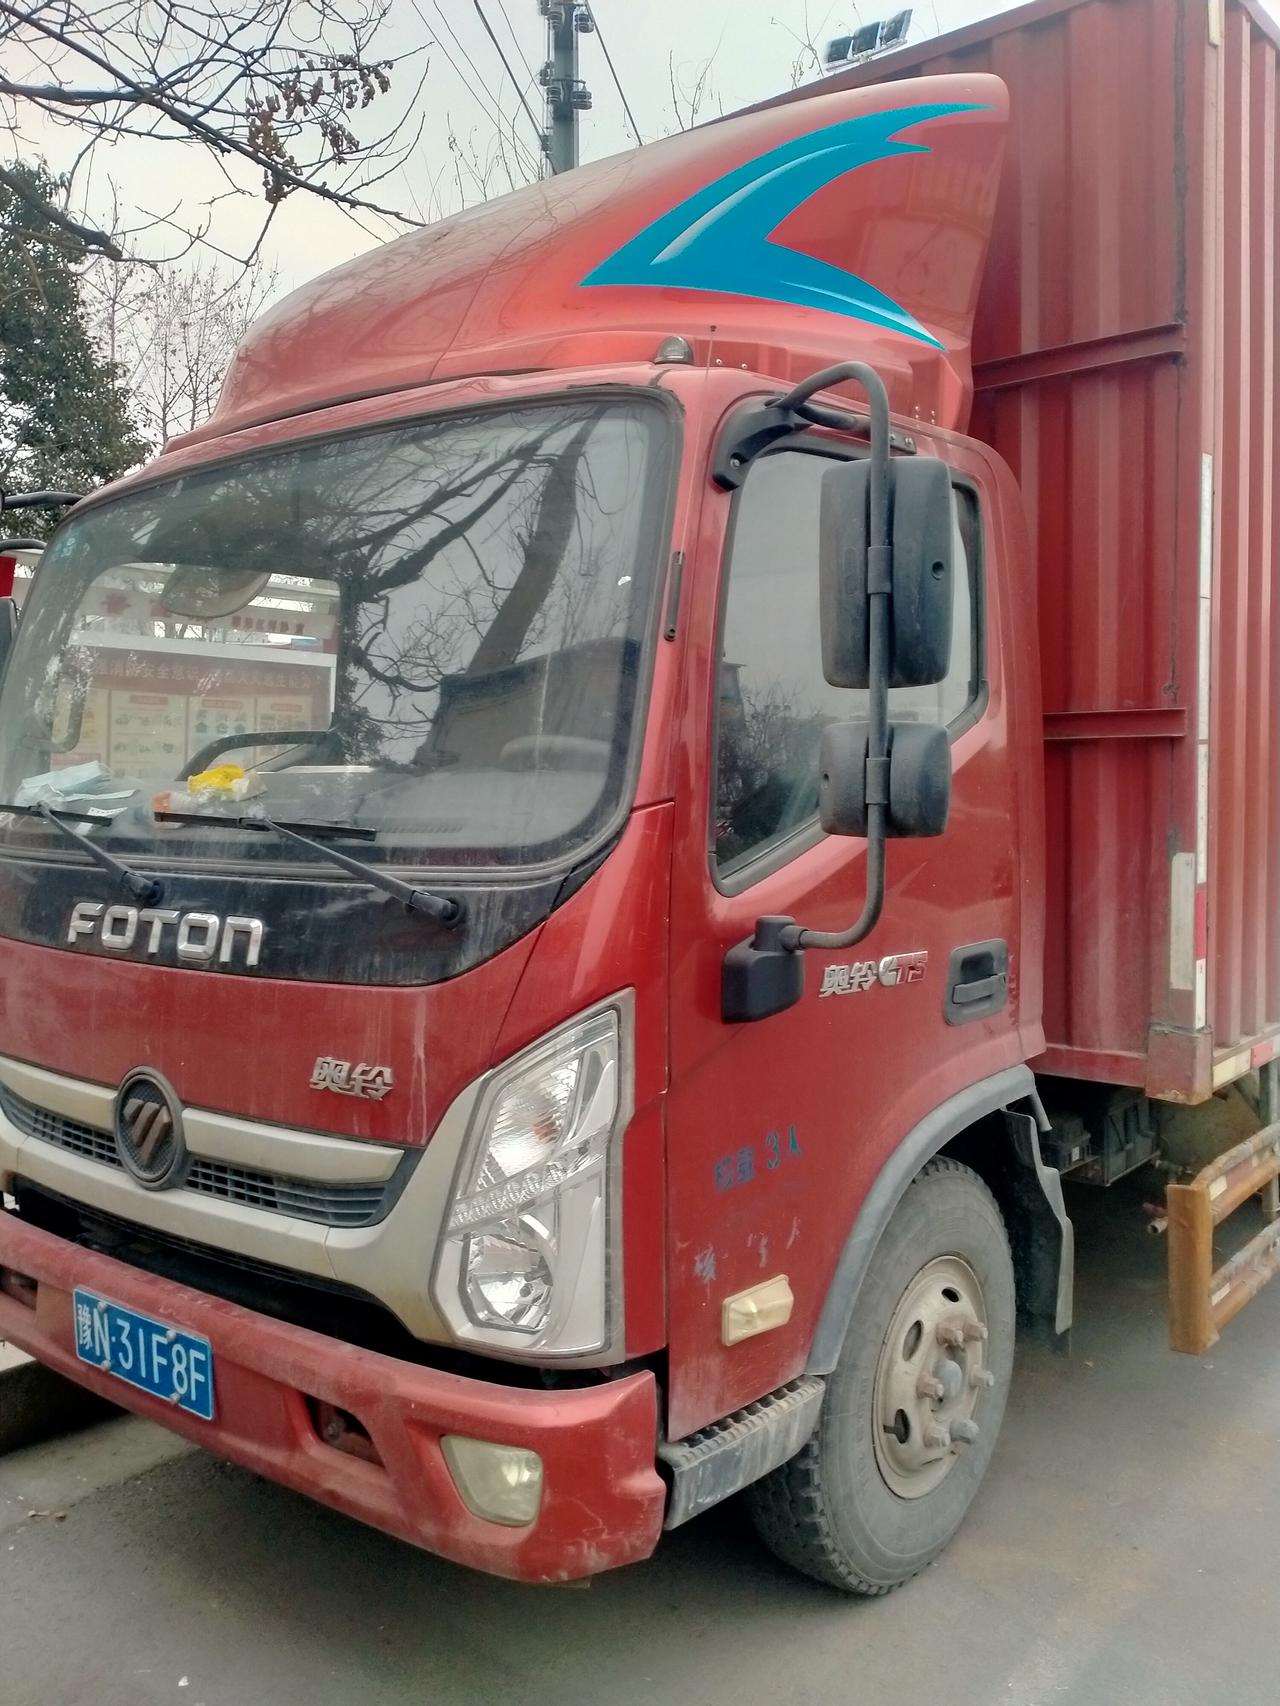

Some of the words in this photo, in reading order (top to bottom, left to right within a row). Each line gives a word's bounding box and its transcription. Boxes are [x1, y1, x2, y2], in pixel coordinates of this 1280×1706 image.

[67, 902, 263, 966] FOTON
[818, 960, 878, 998] 奥铃
[308, 1055, 394, 1101] 奥铃
